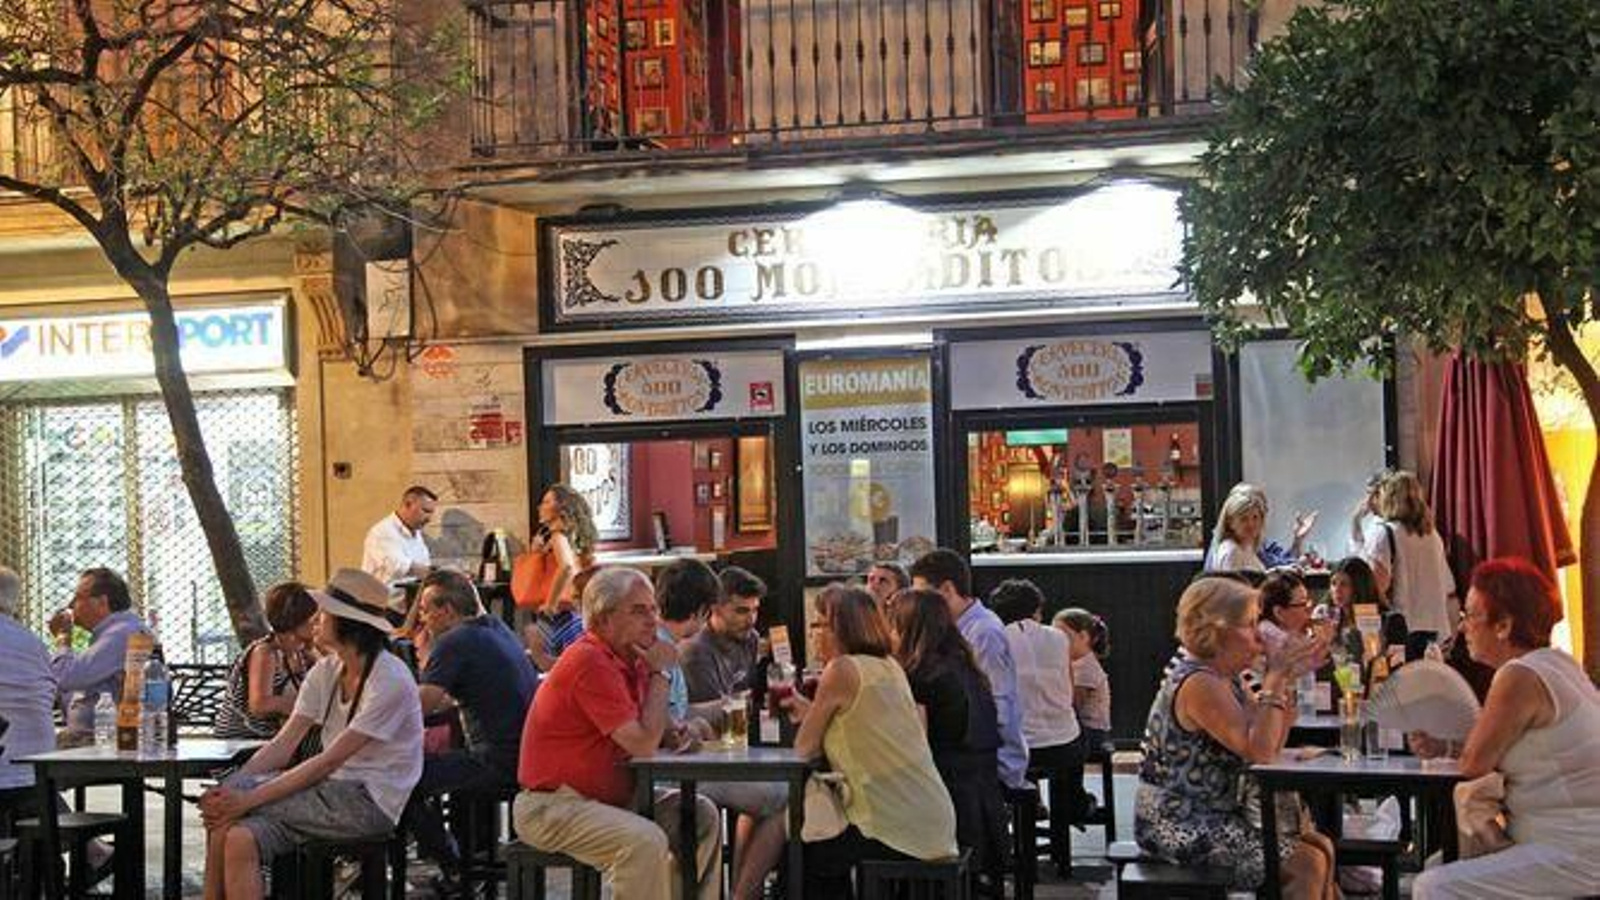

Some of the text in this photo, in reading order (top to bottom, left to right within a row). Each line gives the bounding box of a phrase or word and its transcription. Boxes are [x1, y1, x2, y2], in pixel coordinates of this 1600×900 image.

[728, 214, 998, 257] CERRIA
[39, 312, 273, 356] INTERPORT
[809, 414, 928, 435] LOS MIÉRCOLES
[810, 439, 928, 456] Y LOS DOMINGOS
